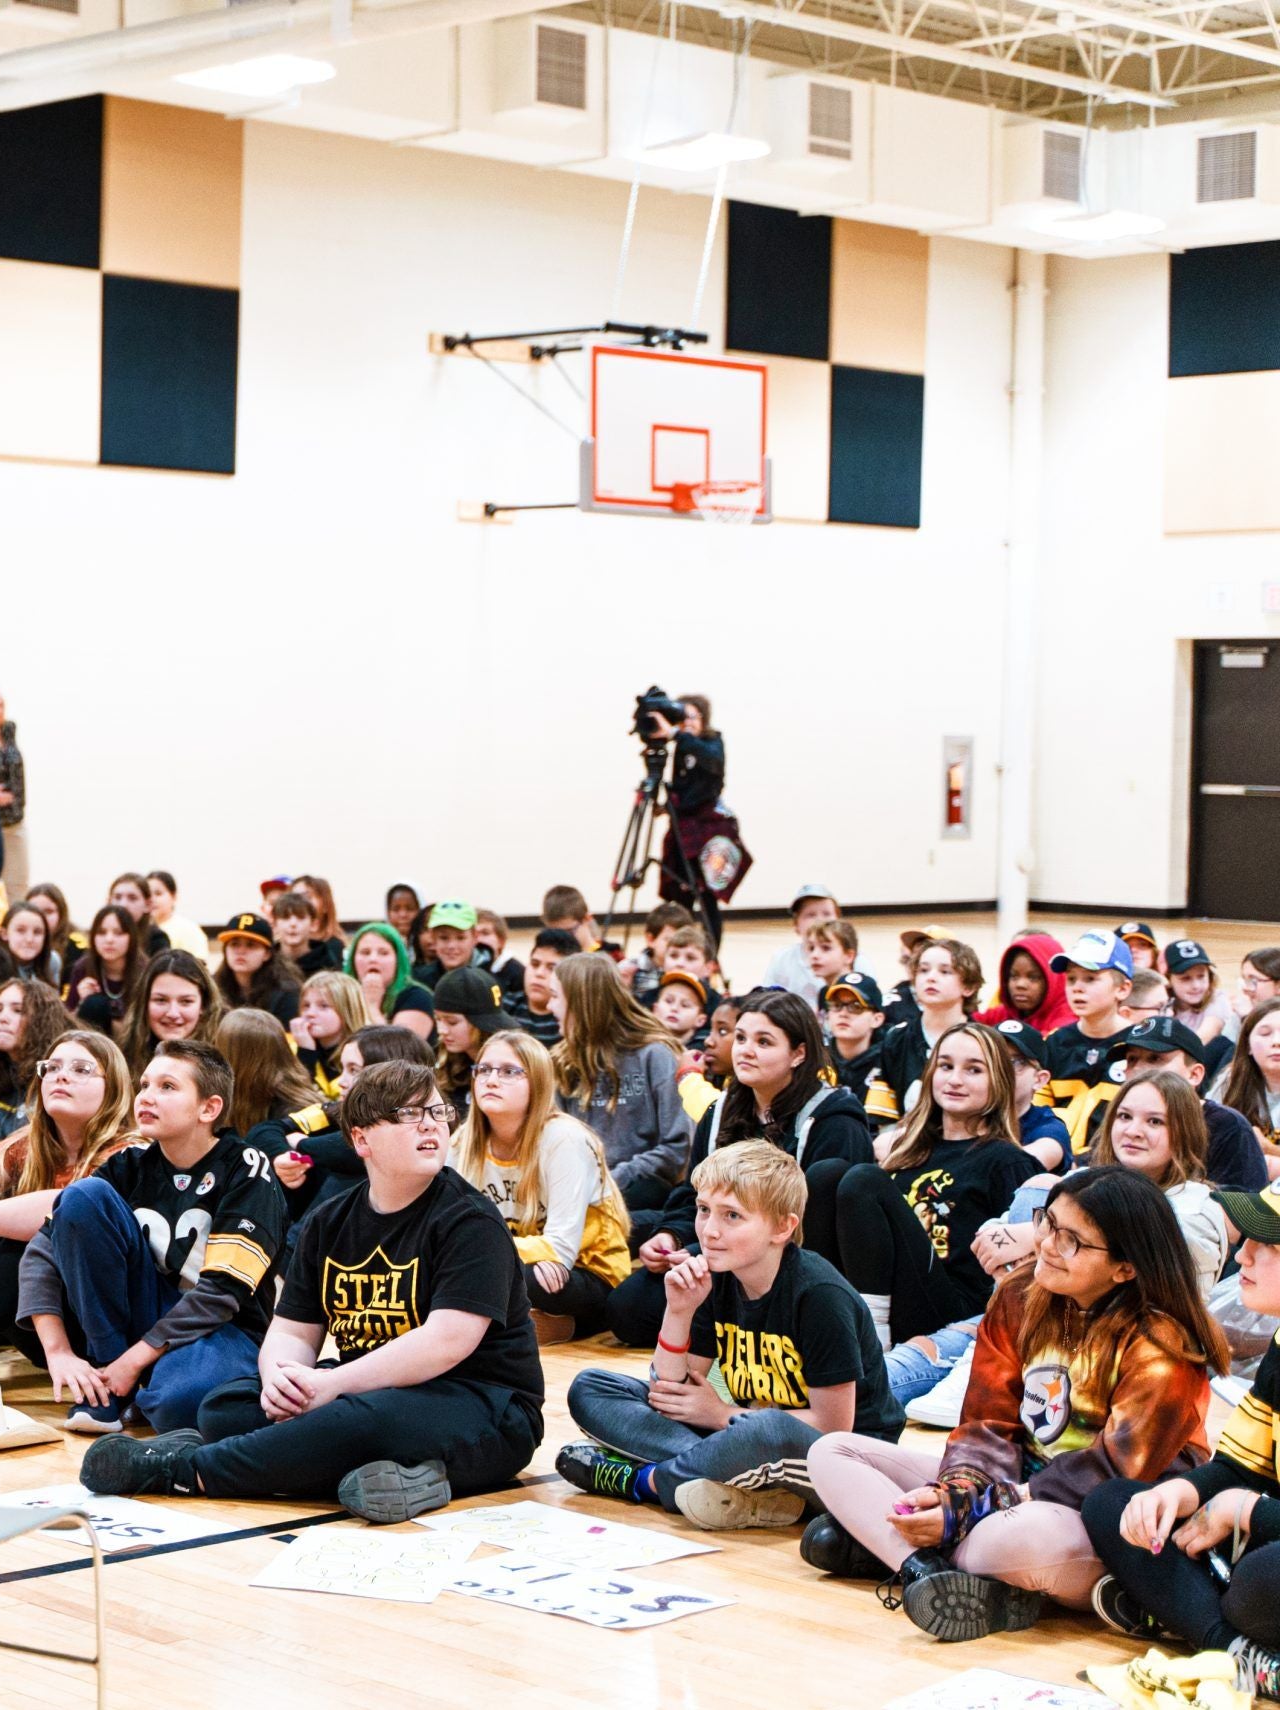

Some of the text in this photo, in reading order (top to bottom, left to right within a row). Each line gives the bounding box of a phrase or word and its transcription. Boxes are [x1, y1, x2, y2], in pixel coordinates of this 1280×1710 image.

[239, 914, 254, 930] P
[242, 1148, 271, 1183] 92
[1024, 1389, 1047, 1406] teelers
